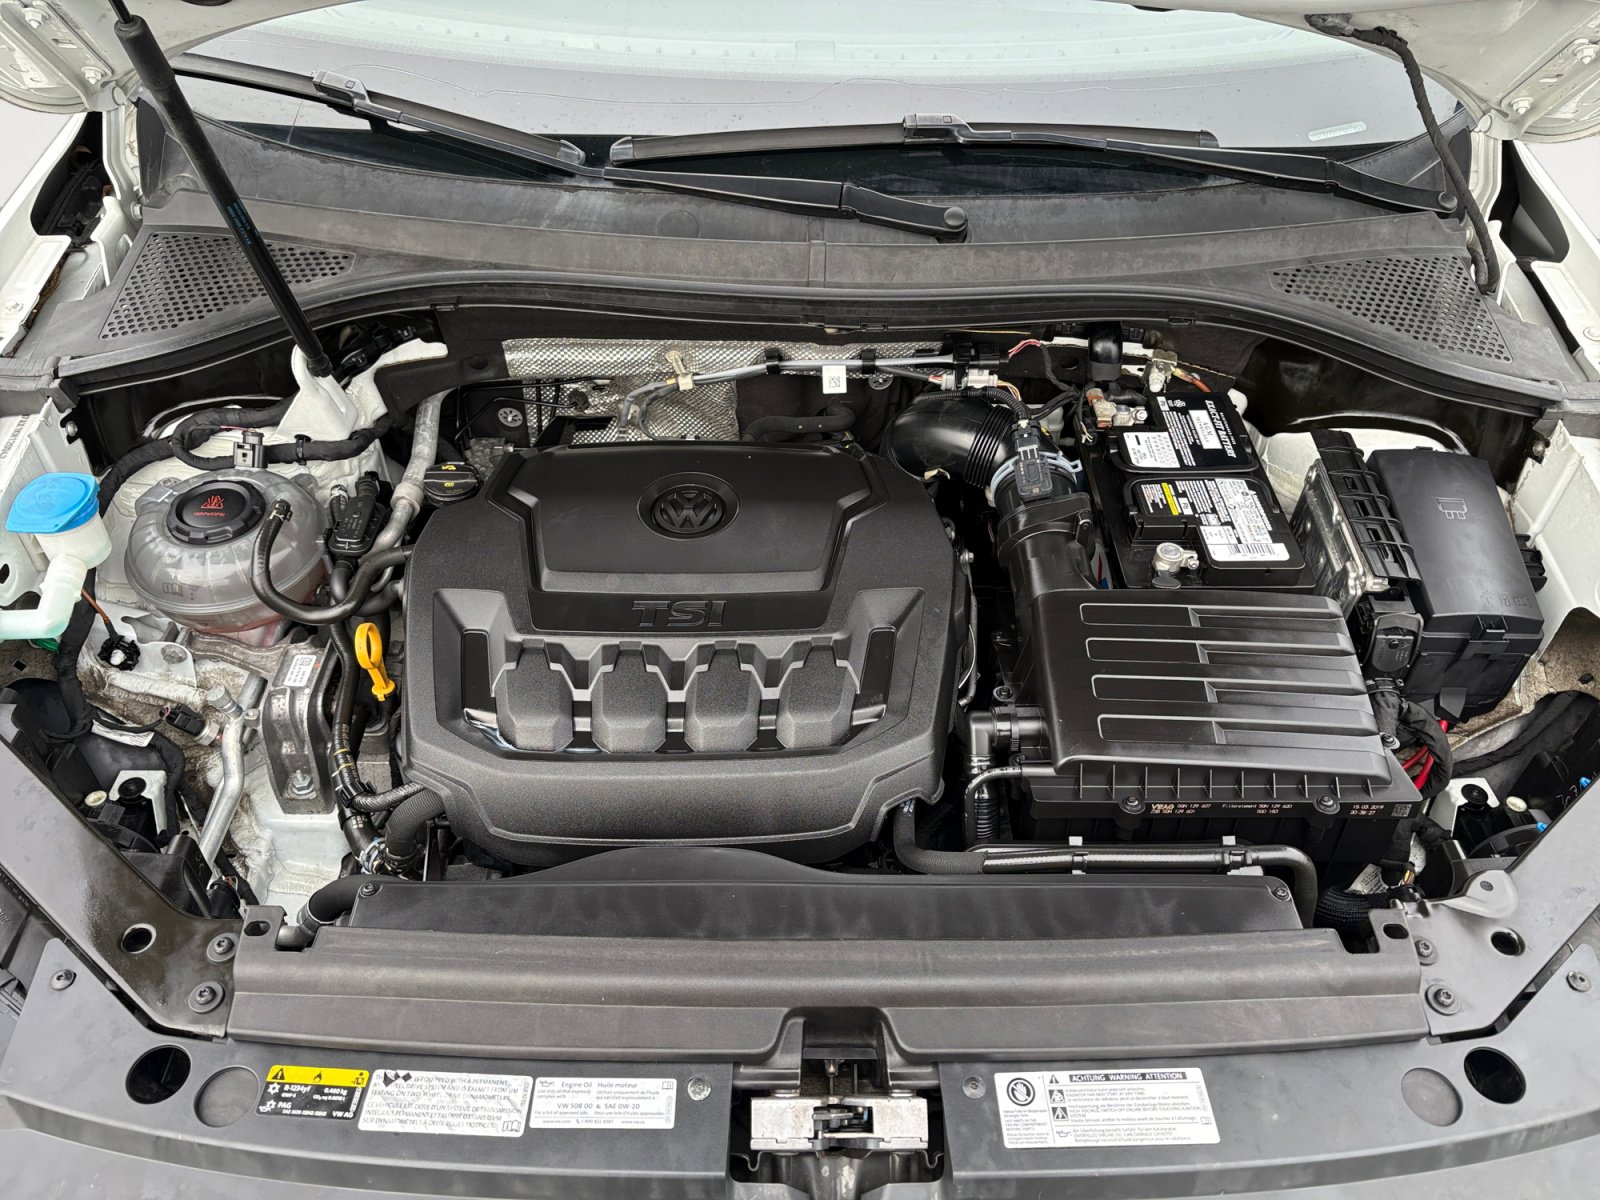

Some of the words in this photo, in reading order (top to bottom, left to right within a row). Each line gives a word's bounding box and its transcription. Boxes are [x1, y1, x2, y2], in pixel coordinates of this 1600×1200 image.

[1203, 422, 1214, 436] AGM
[1204, 400, 1225, 430] EXACT-FIT
[1217, 430, 1237, 458] BATTERY
[632, 600, 727, 627] TSI
[1072, 1074, 1106, 1082] ACHTUNG
[1108, 1073, 1142, 1081] WARNING
[1146, 1072, 1183, 1080] ATTENTION
